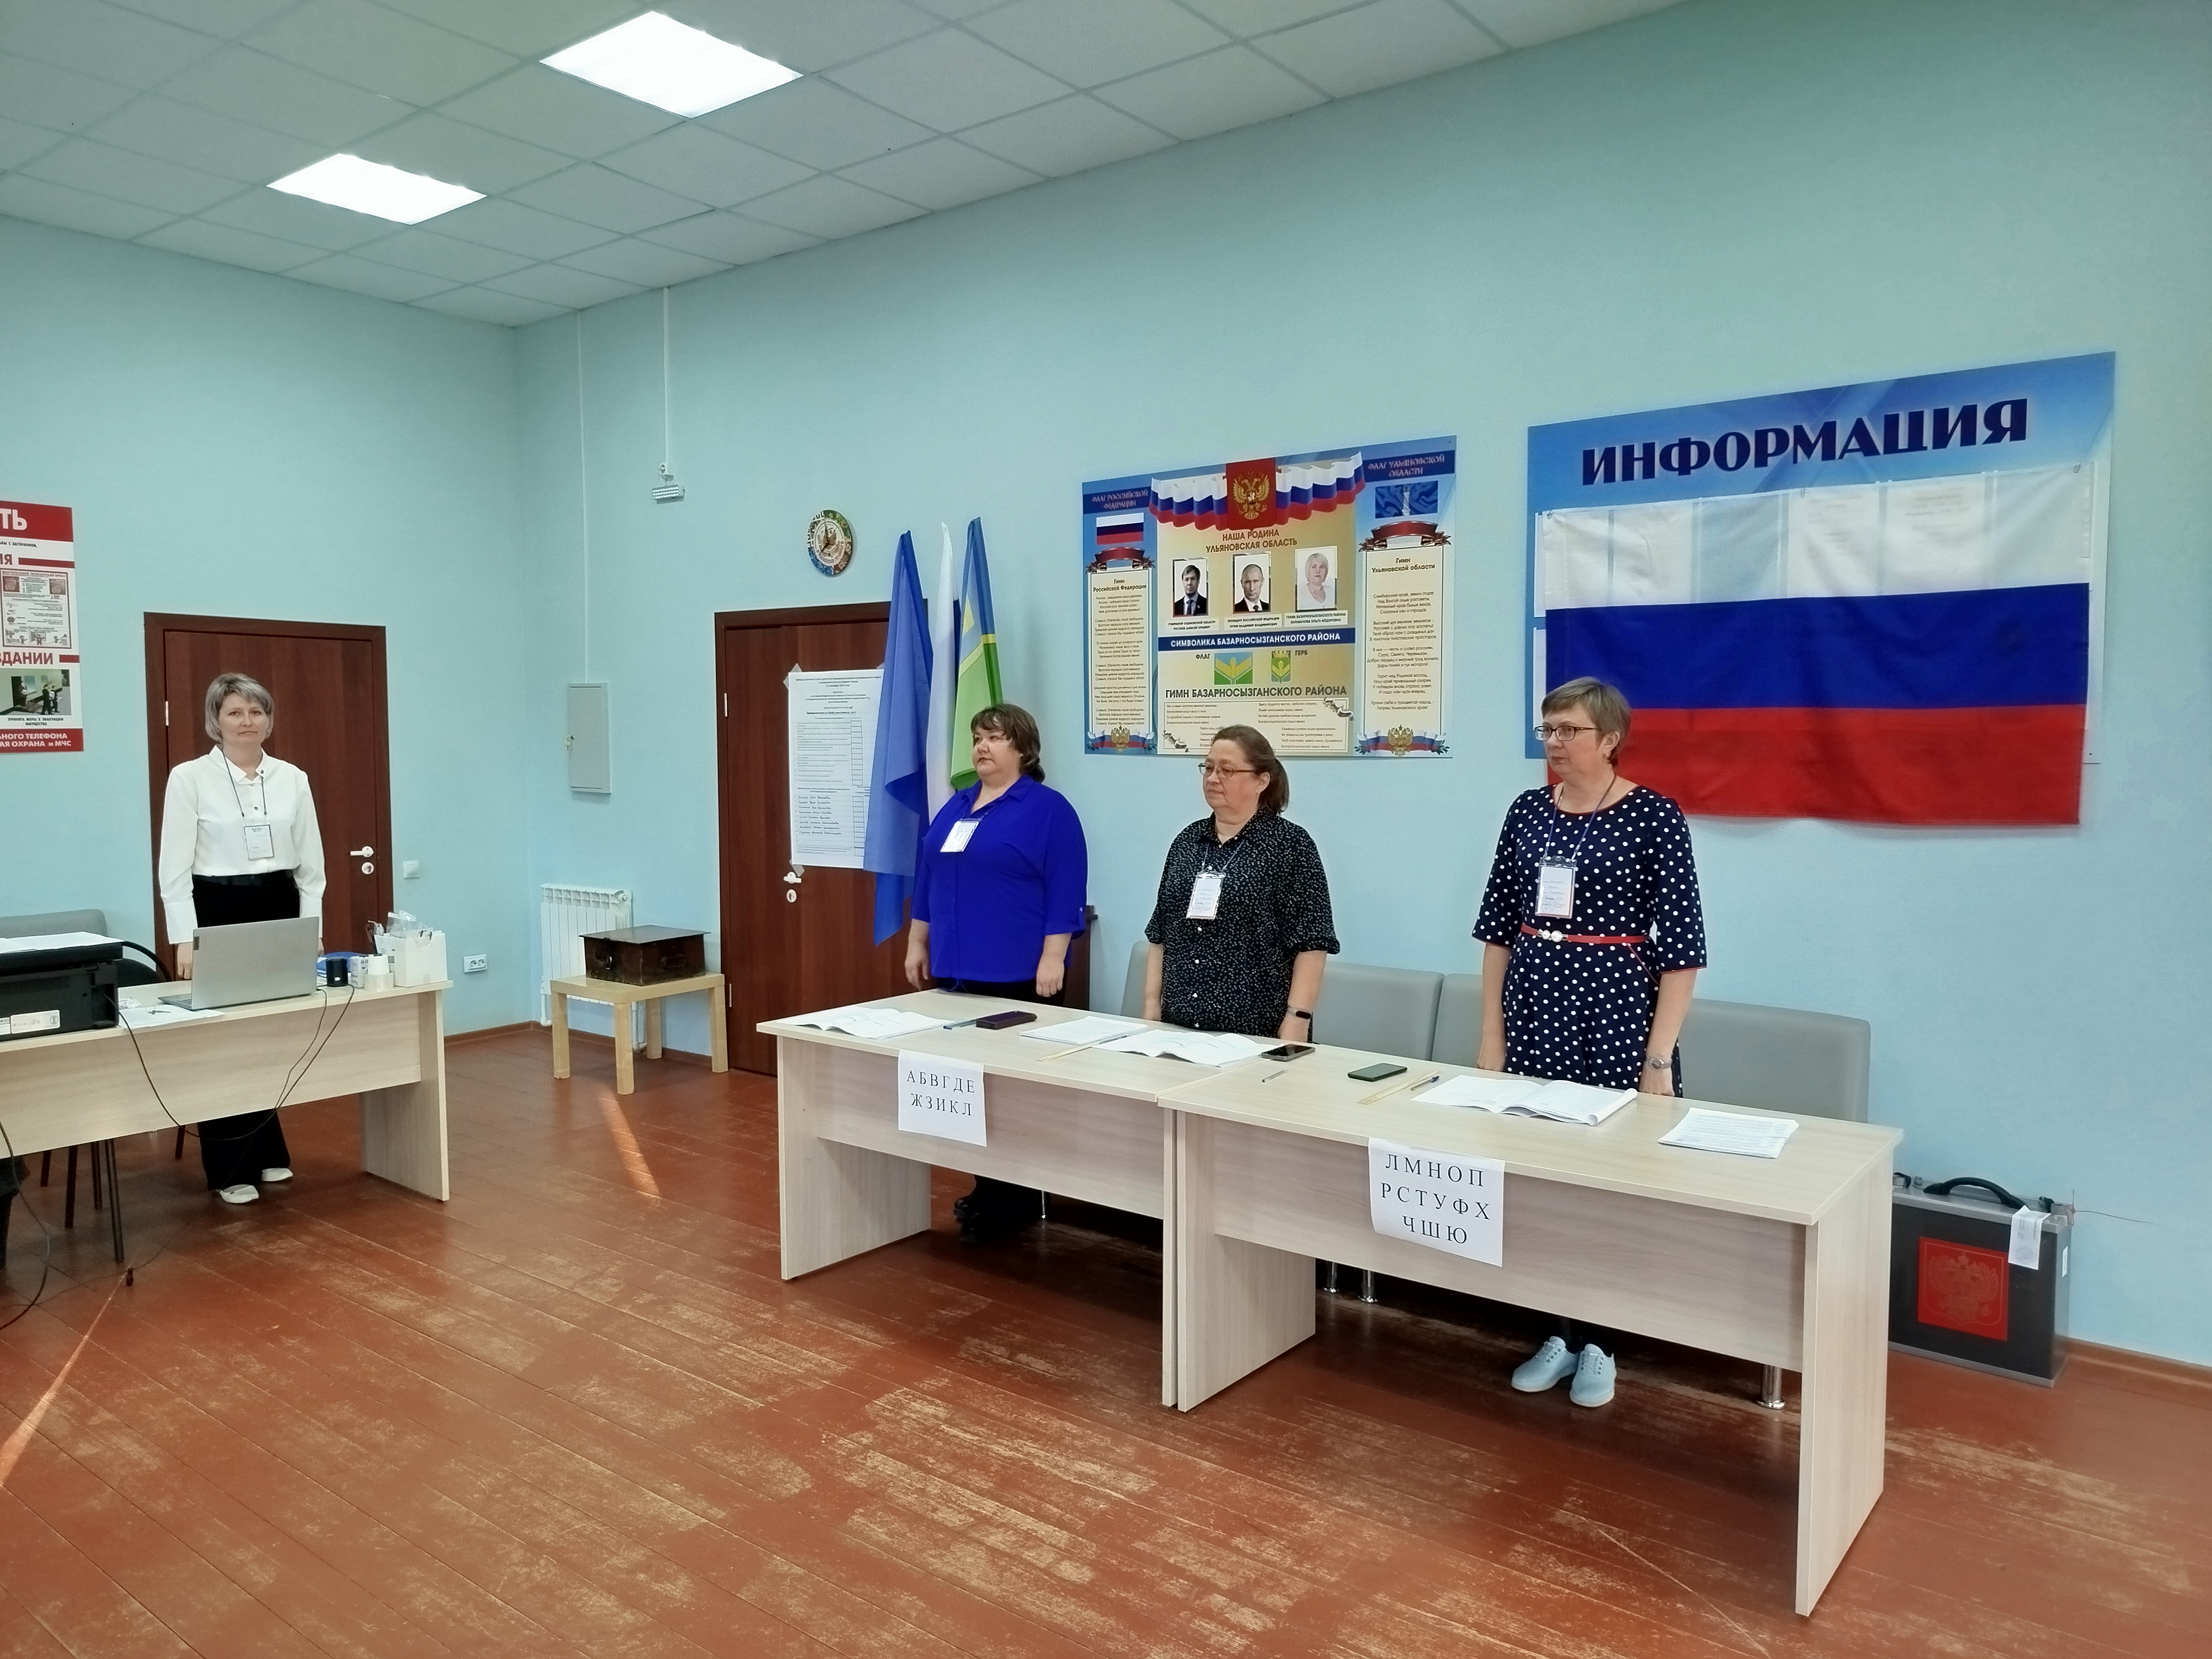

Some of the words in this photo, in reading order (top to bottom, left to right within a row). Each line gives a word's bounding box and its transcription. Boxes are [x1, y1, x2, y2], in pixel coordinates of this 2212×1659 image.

[1582, 398, 2027, 486] ИНФОРМАЦИЯ
[1389, 454, 1444, 468] УЛЬЯНОВСКОЙ
[1389, 468, 1423, 477] ОБЛАСТИ
[1223, 533, 1245, 541] НАША
[1248, 529, 1279, 540] РОДИНА
[1206, 541, 1260, 553] УЛЬЯНОВСКАЯ
[1262, 538, 1297, 548] ОБЛАСТЬ
[1171, 638, 1215, 647] СИМВОЛИКА
[1217, 634, 1306, 645] БАЗАРНОСЫЗГАНСКОГО
[1307, 633, 1340, 641] РАЙОНА
[0, 651, 53, 666] ДАНИИ
[1166, 689, 1189, 698] ГИМН
[1192, 686, 1302, 698] БАЗАРНОСЫЗГАНСКОГО
[1305, 684, 1347, 696] РАЙОНА
